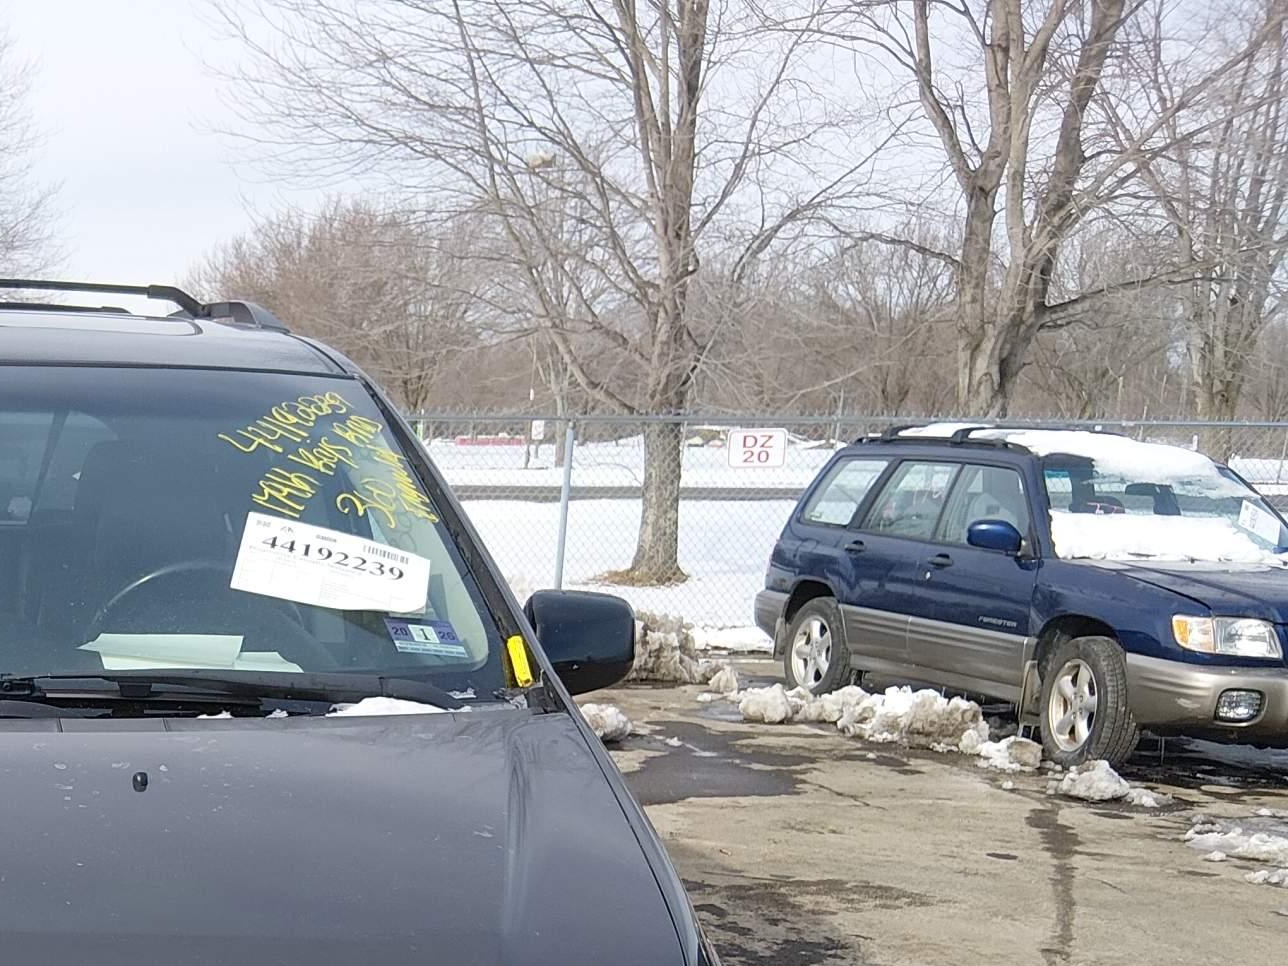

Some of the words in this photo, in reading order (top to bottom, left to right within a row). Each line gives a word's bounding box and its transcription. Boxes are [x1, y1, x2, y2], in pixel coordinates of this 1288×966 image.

[742, 434, 774, 449] DZ
[742, 450, 770, 463] 20
[262, 535, 405, 581] 44192239
[419, 628, 431, 641] 1
